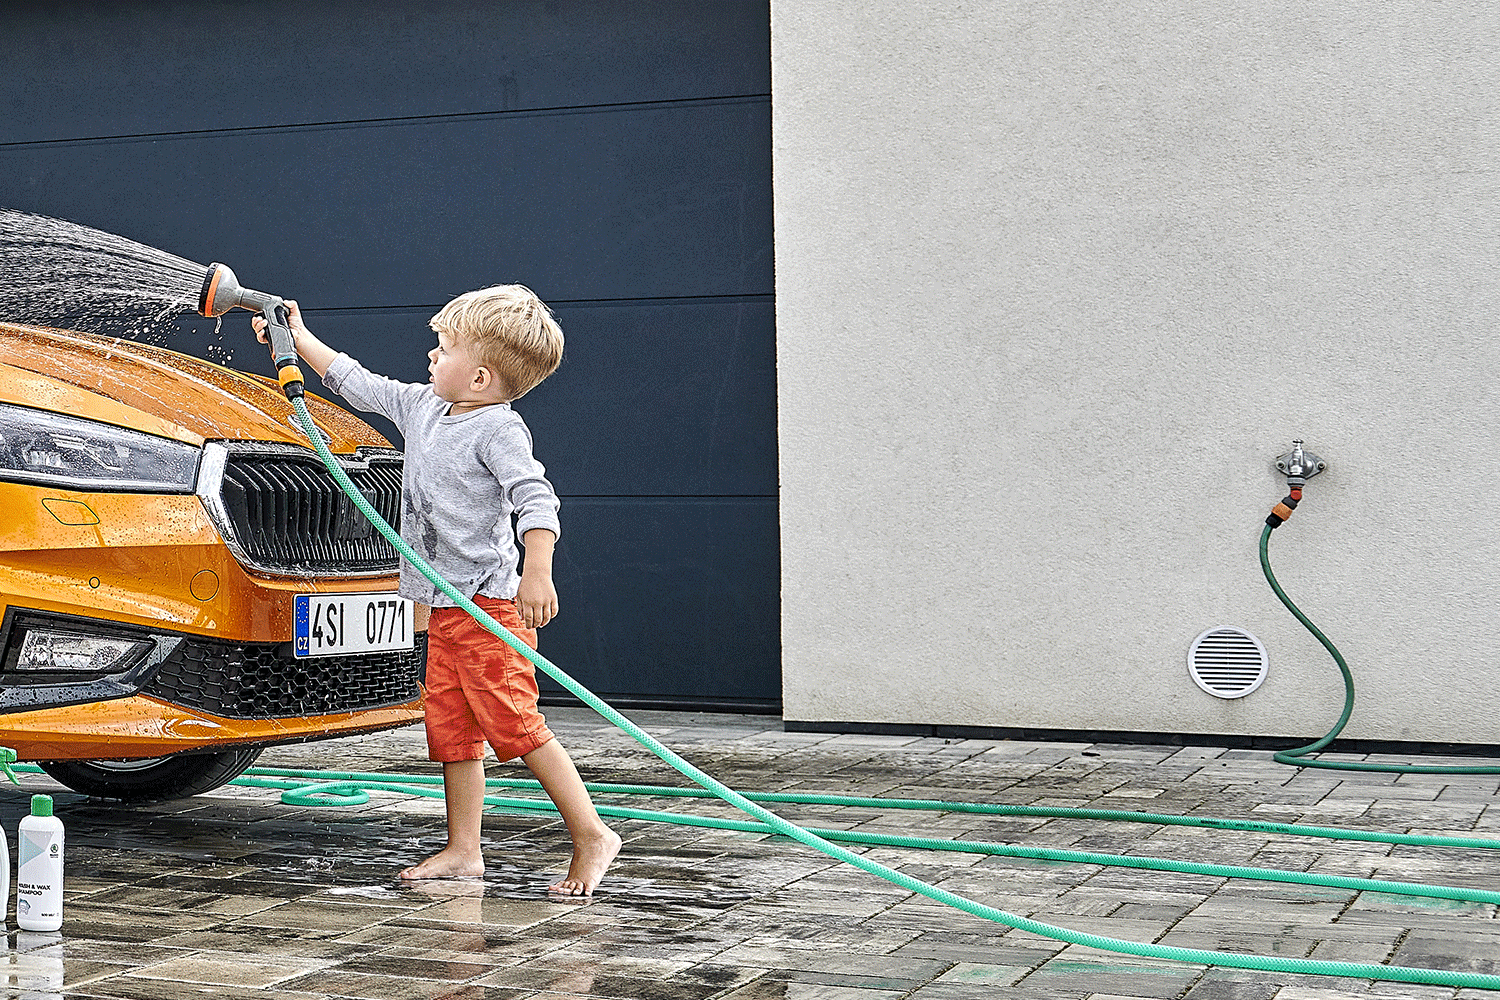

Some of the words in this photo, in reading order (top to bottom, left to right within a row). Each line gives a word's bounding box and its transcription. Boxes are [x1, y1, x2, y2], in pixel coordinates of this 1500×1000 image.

[312, 602, 344, 648] 4SI
[366, 600, 405, 645] 0771
[297, 636, 309, 651] CZ
